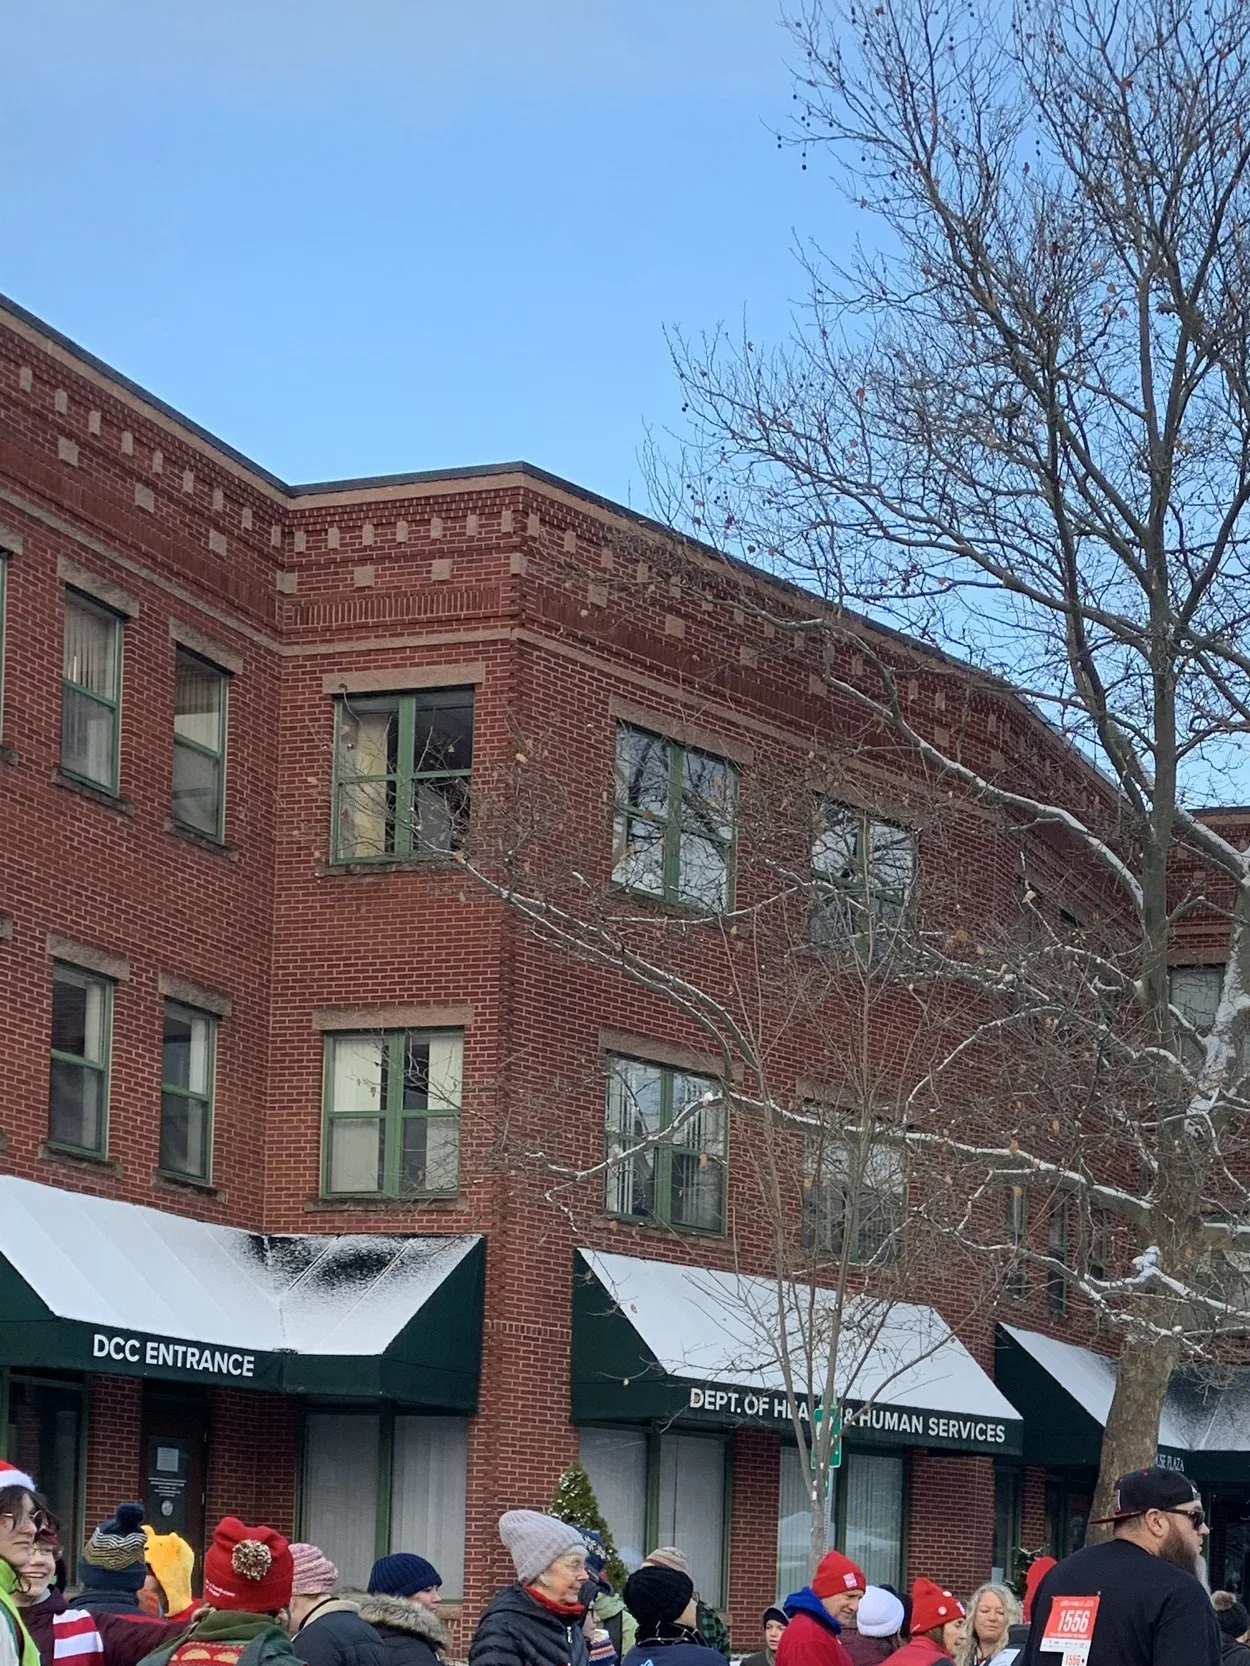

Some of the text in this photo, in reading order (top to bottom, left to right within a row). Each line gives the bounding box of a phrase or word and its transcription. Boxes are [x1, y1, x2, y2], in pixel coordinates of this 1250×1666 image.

[93, 1334, 254, 1377] DCC ENTRANCE
[690, 1388, 741, 1413] DEPT.
[744, 1395, 769, 1416] OF
[860, 1410, 923, 1434] HUMAN
[928, 1417, 1005, 1442] SERVICES
[1058, 1609, 1090, 1633] 1556
